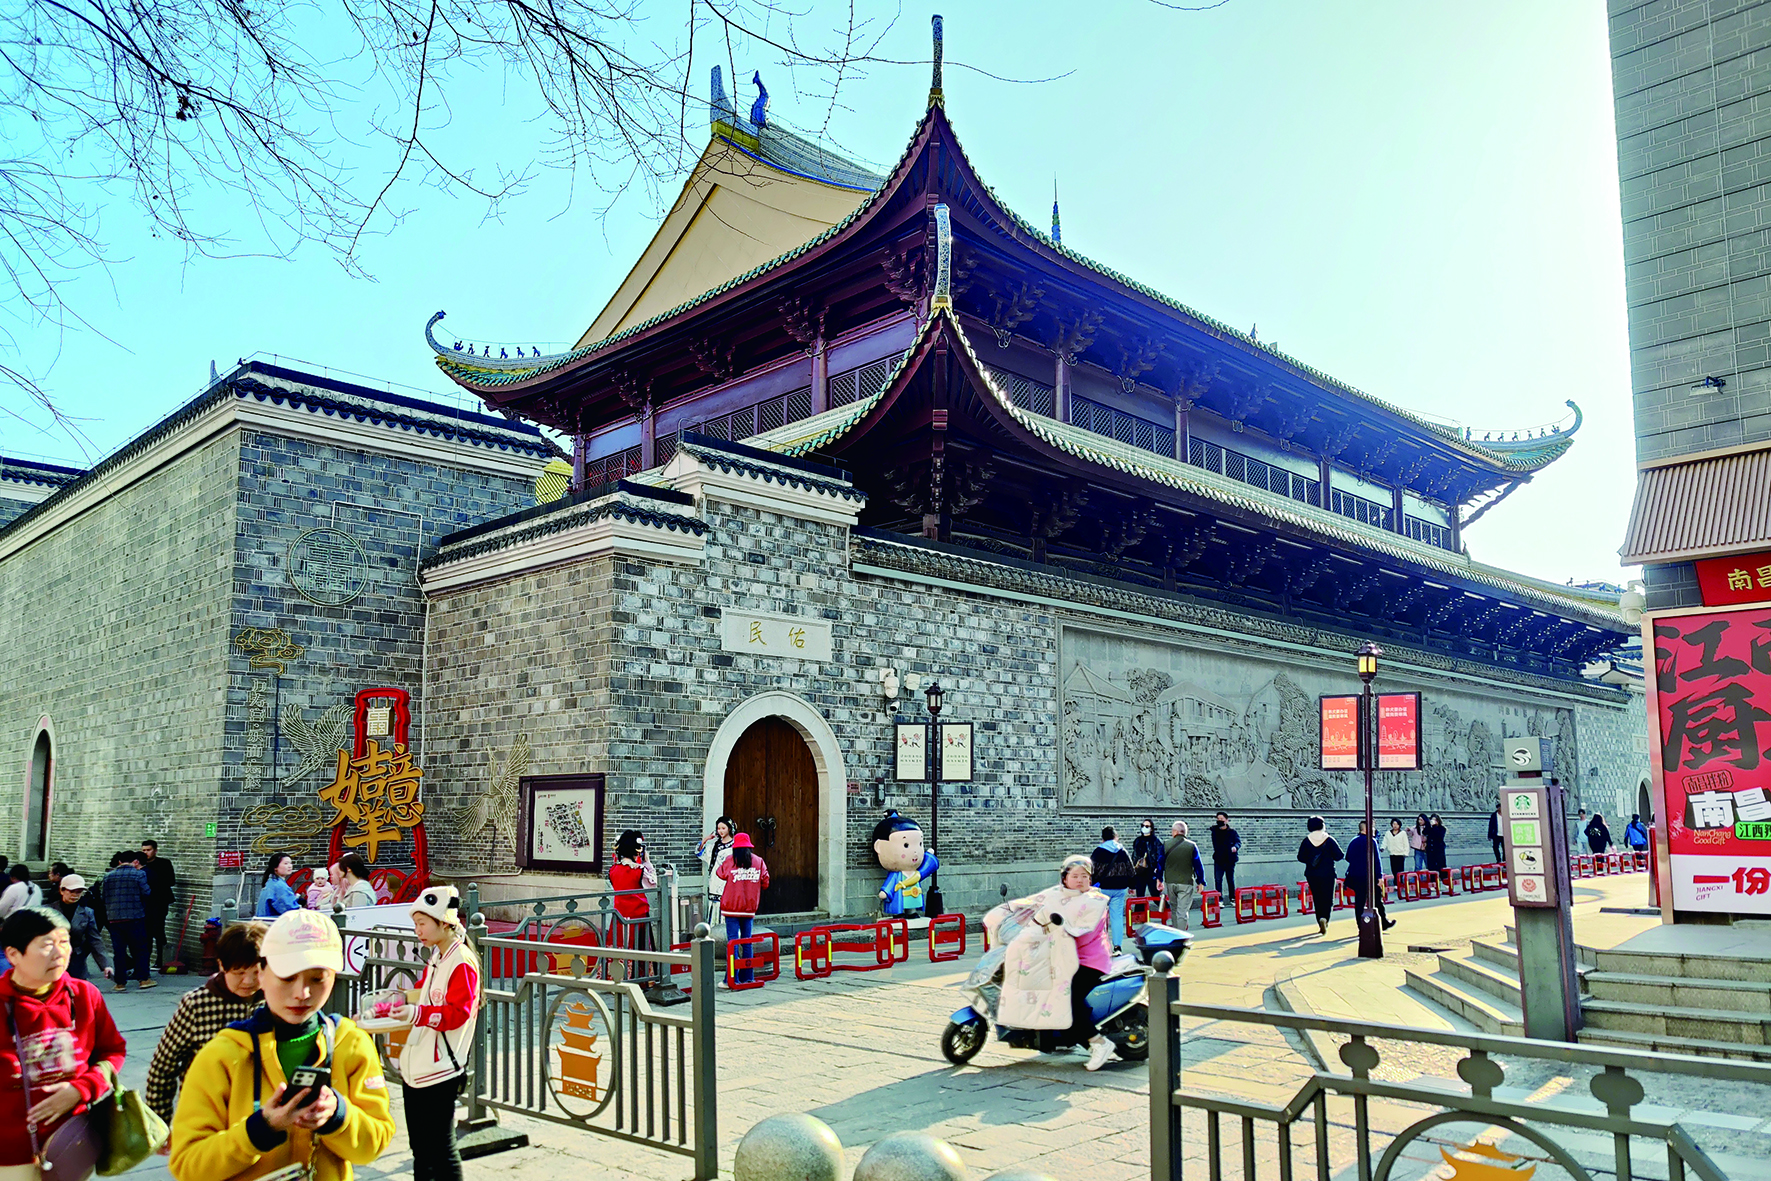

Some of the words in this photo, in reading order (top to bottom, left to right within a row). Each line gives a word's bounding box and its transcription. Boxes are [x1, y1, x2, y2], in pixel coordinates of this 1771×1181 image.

[1655, 619, 1771, 693] 江
[1662, 682, 1771, 772] 厨
[1688, 787, 1771, 828] 南昌
[1695, 893, 1711, 901] GIFT
[1696, 885, 1723, 894] JIANGXI
